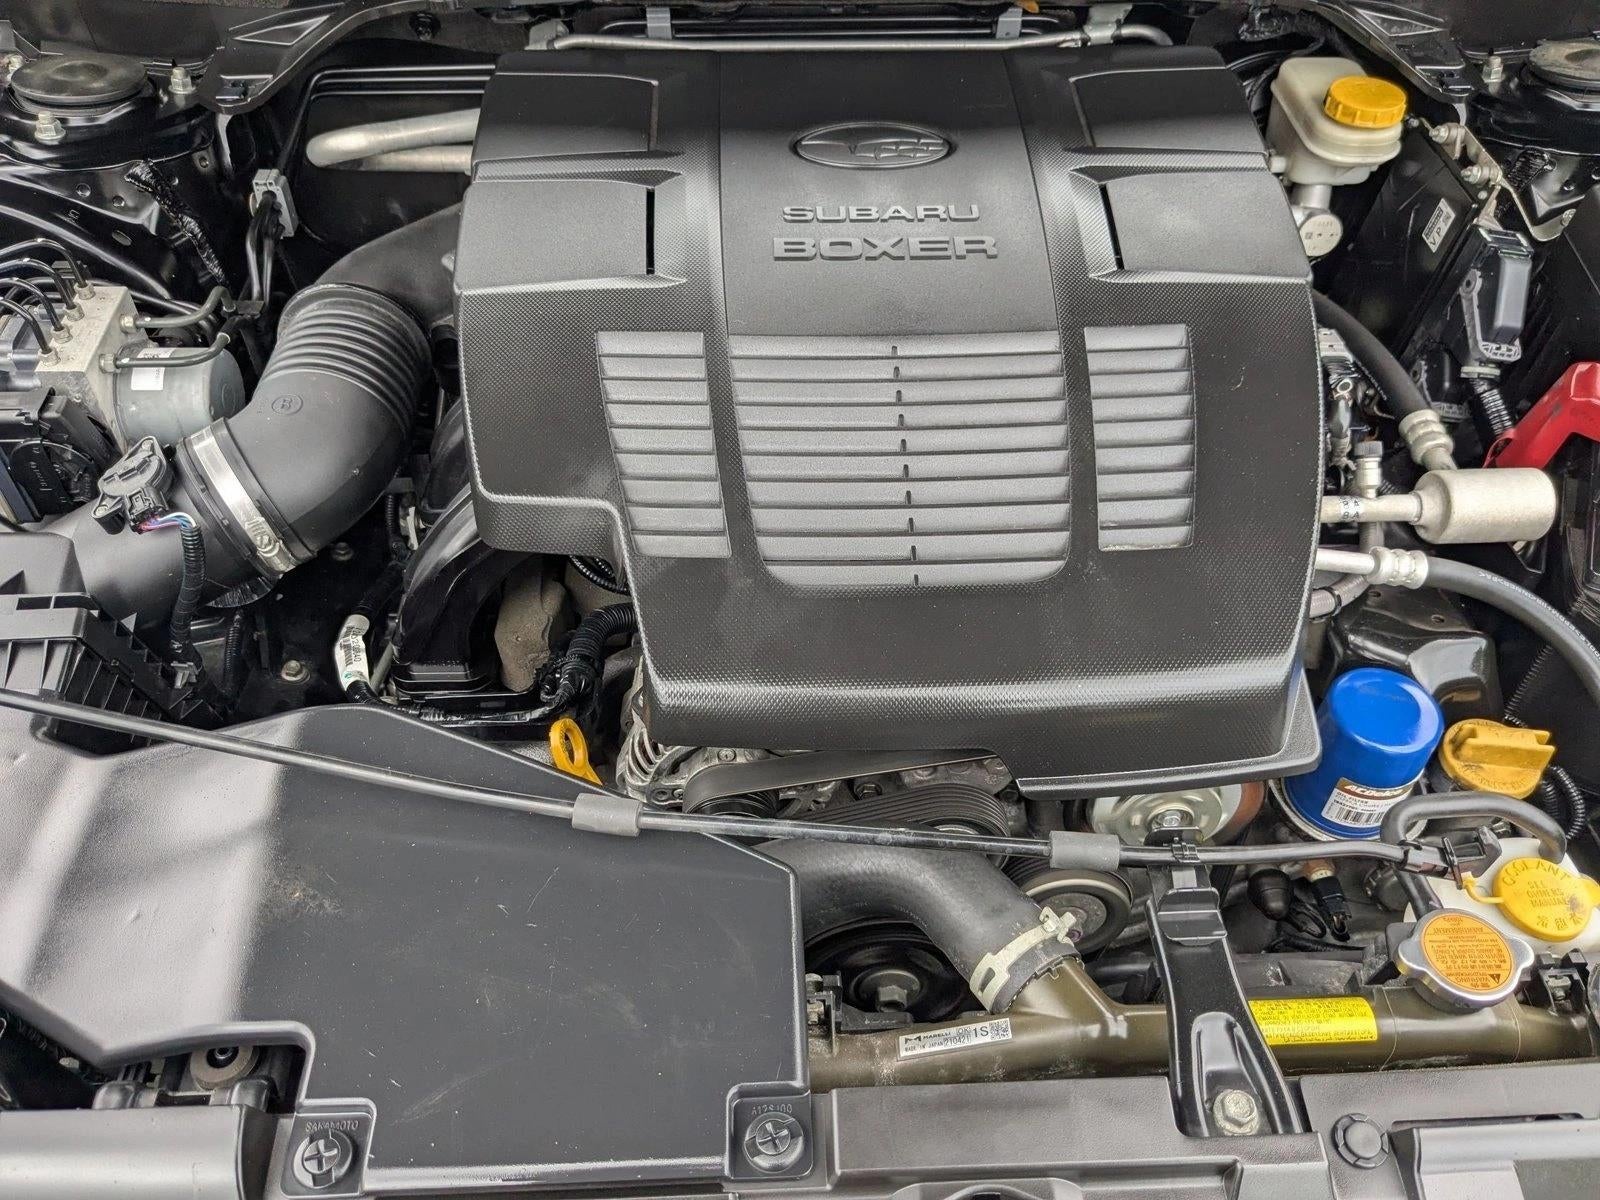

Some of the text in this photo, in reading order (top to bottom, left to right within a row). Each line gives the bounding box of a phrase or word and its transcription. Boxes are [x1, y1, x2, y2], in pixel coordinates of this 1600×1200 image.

[782, 204, 981, 223] SUBARU
[773, 235, 998, 261] BOXER
[973, 1026, 989, 1038] 1S
